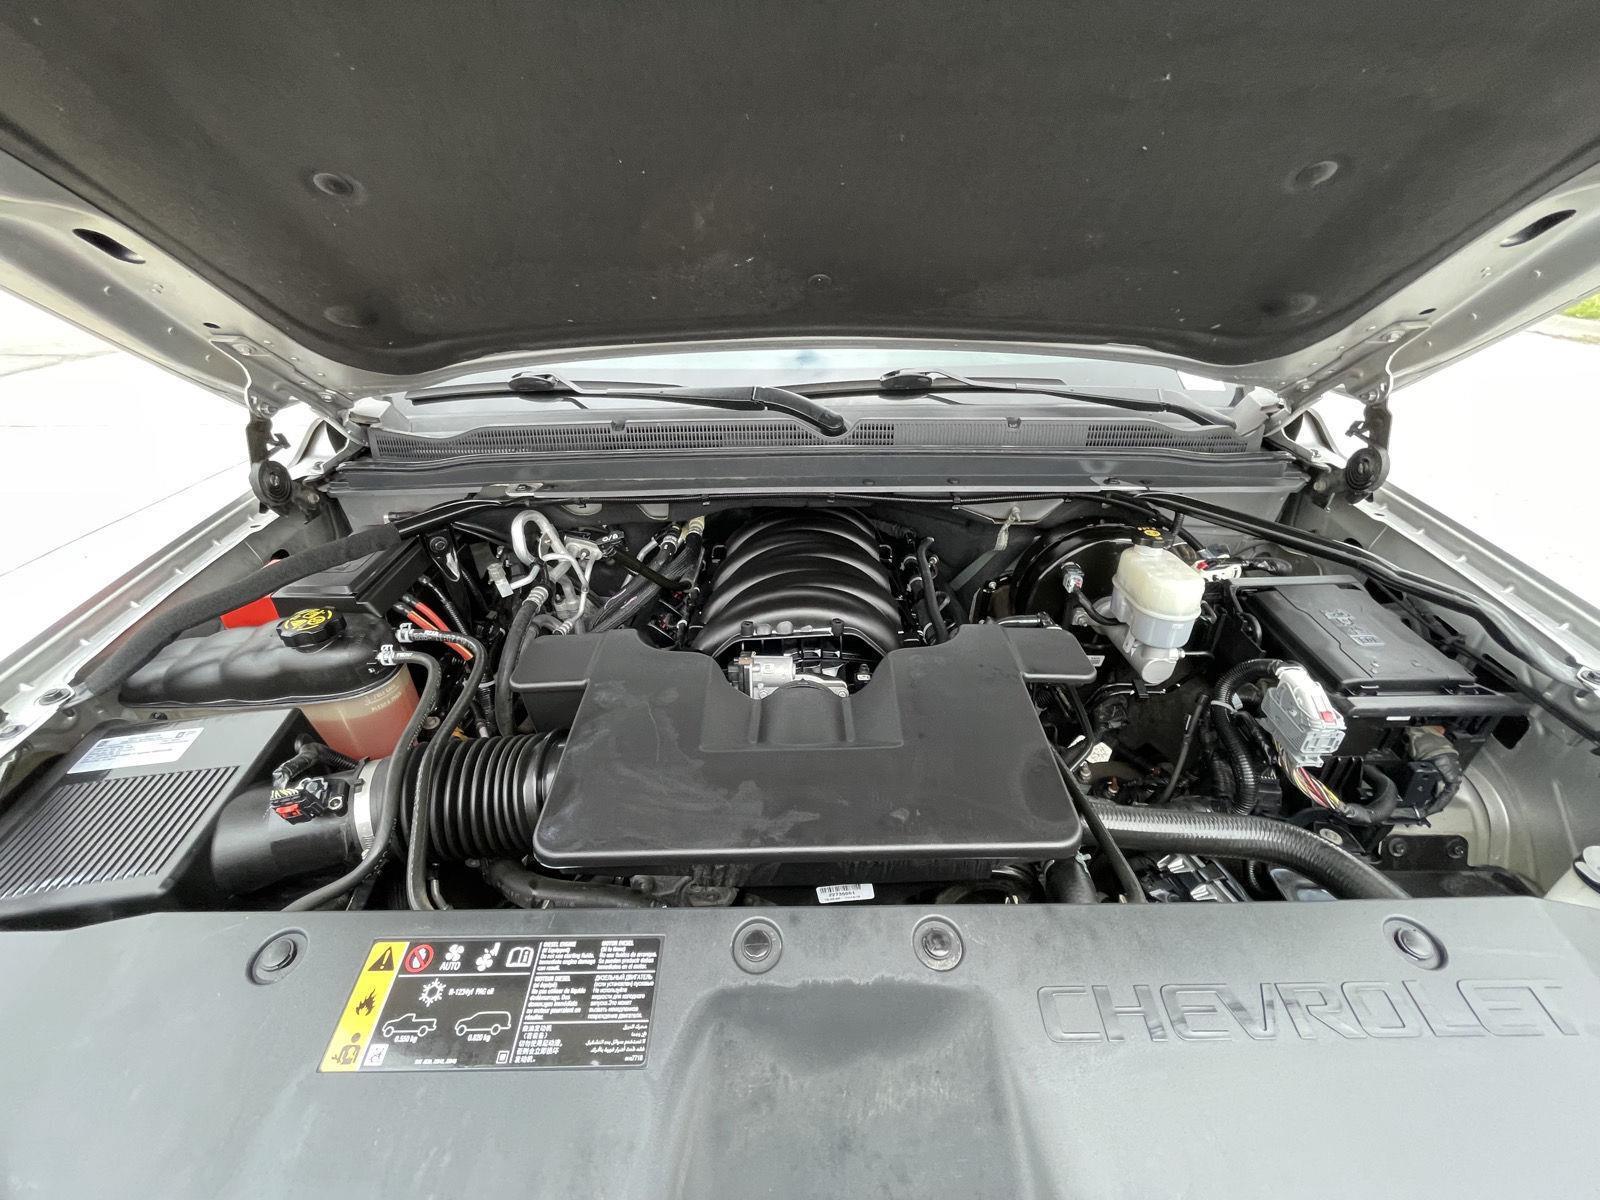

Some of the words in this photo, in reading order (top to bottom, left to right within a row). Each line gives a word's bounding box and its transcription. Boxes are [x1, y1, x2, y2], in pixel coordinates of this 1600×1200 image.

[439, 961, 461, 970] AUTO
[448, 988, 474, 997] R-1234yf
[1036, 979, 1580, 1043] CHEVROLET
[410, 1035, 418, 1043] kg
[483, 1034, 491, 1042] kg
